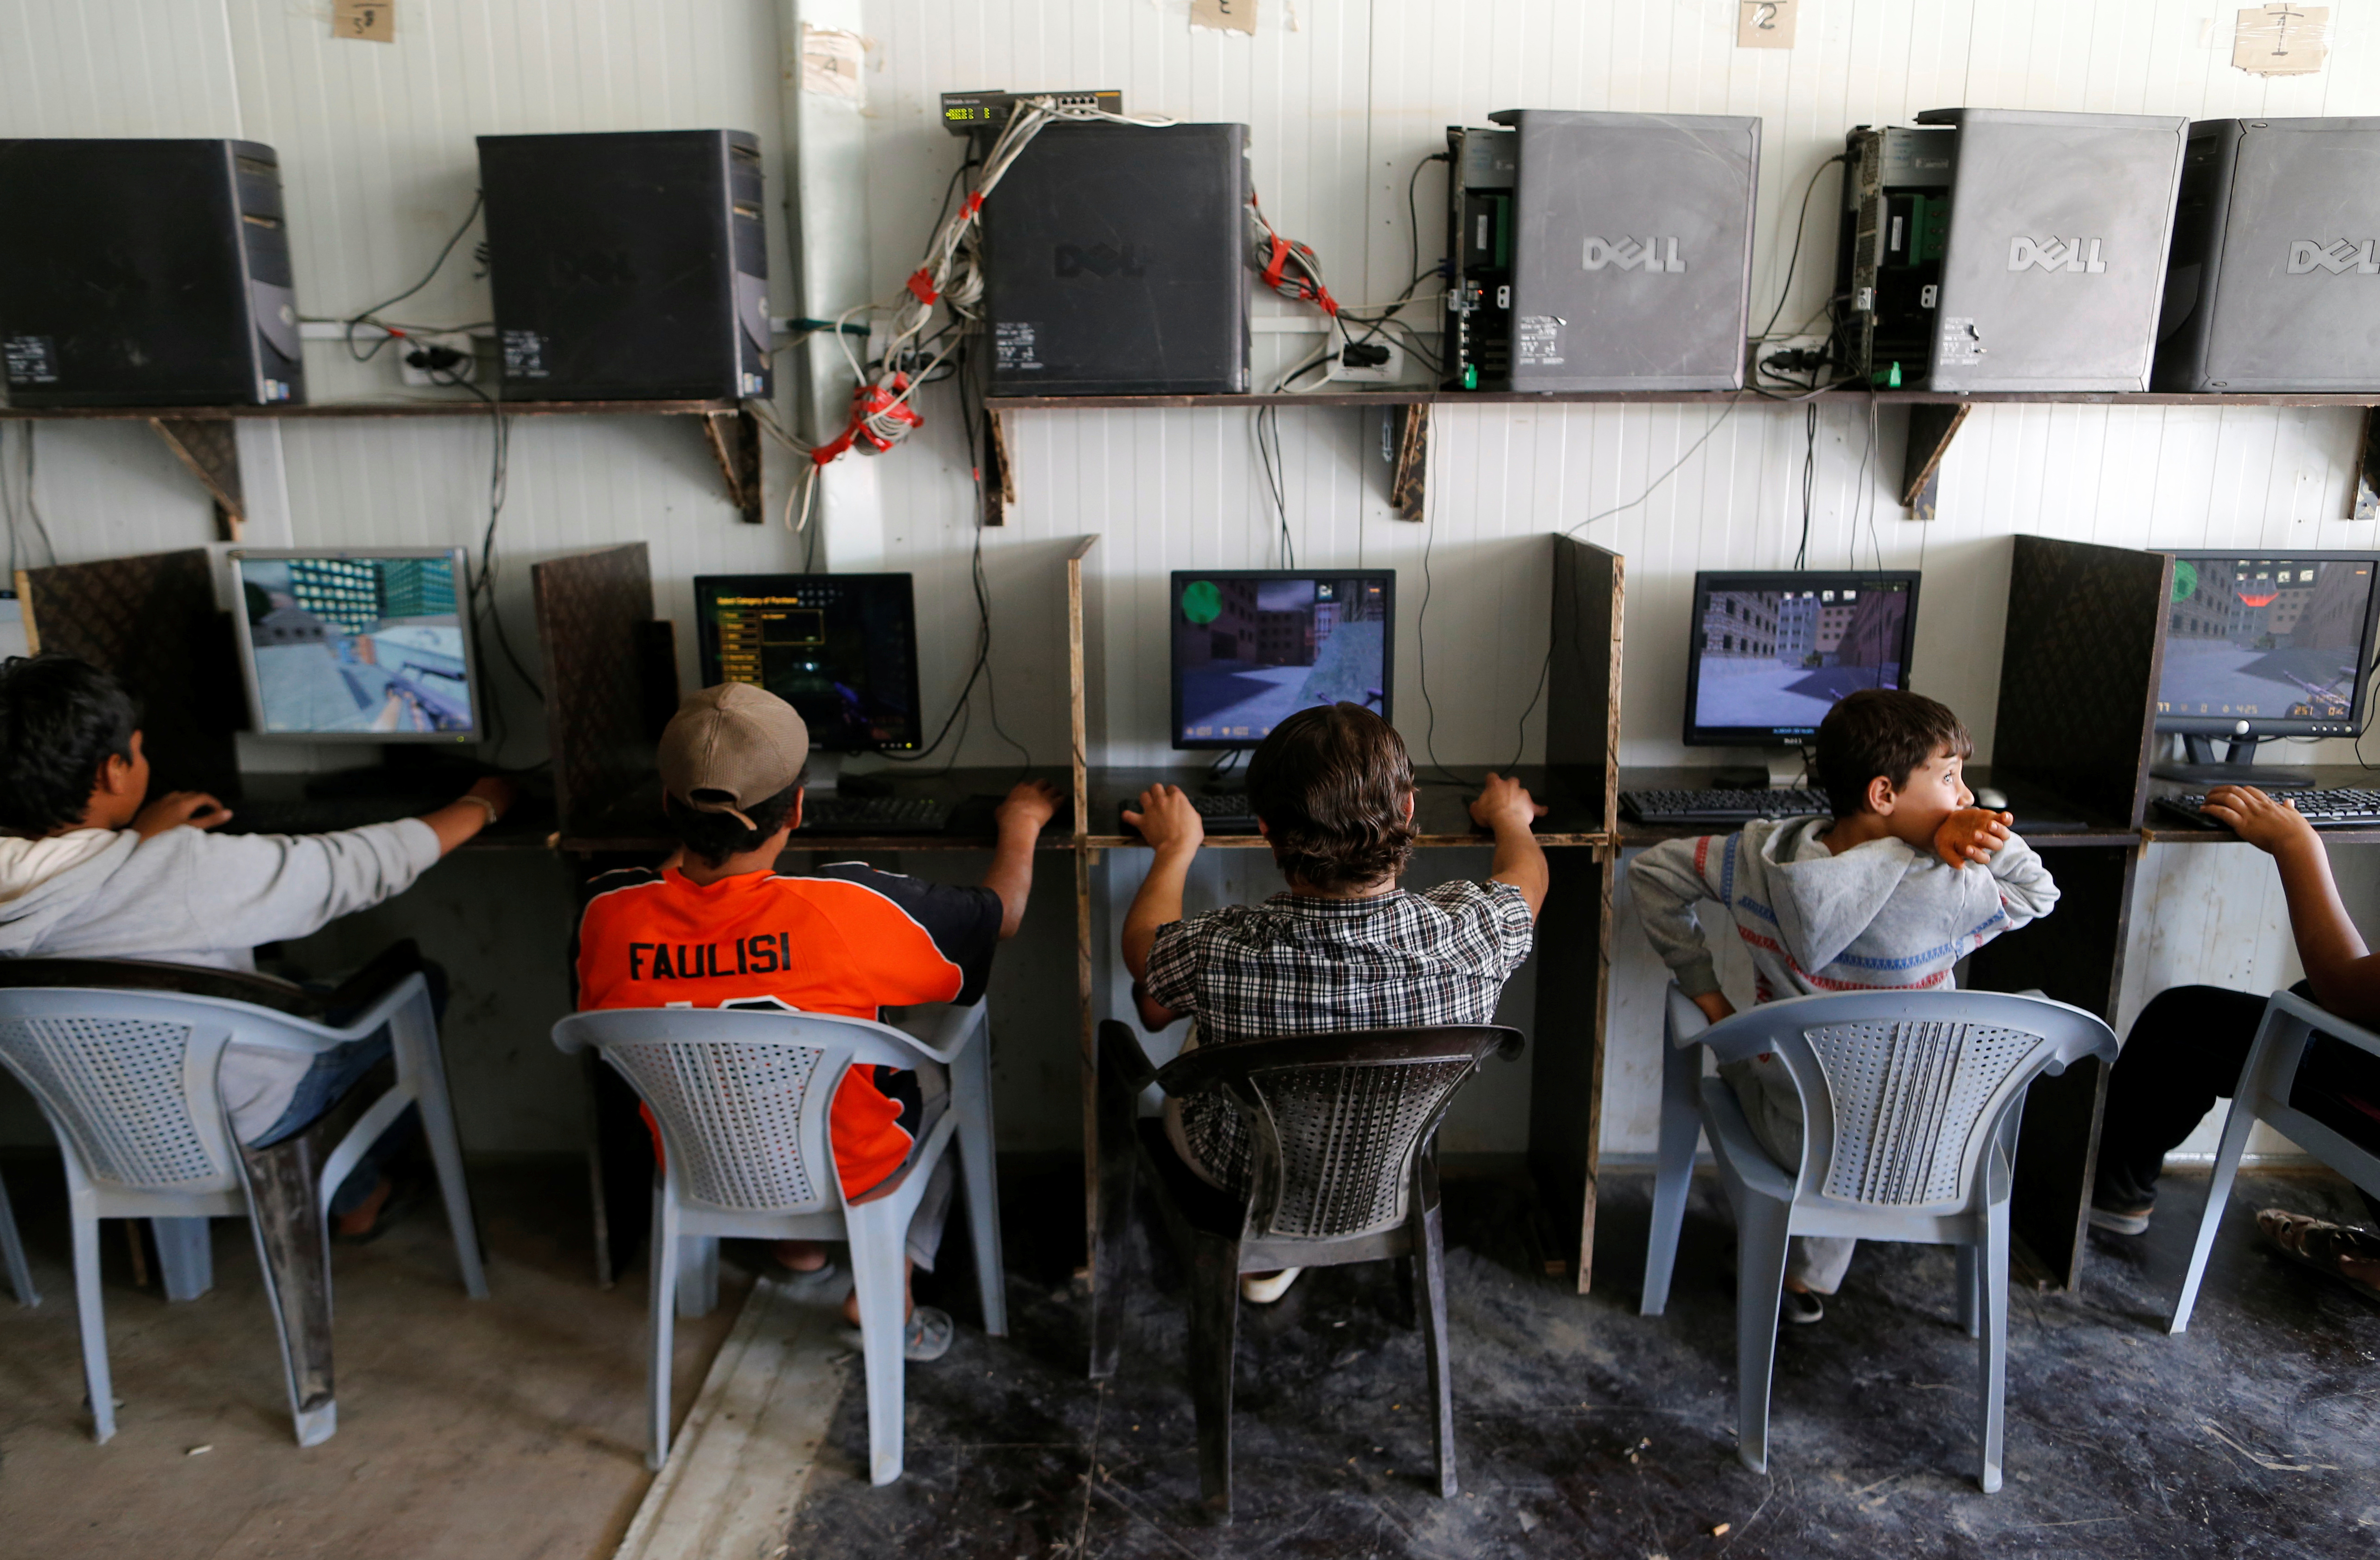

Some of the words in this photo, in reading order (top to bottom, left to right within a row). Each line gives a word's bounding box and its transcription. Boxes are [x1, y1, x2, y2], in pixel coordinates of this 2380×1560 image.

[1759, 3, 1777, 29] 2
[1582, 234, 1687, 273] DELL
[2008, 235, 2107, 274] DELL
[629, 932, 791, 980] FAULISI
